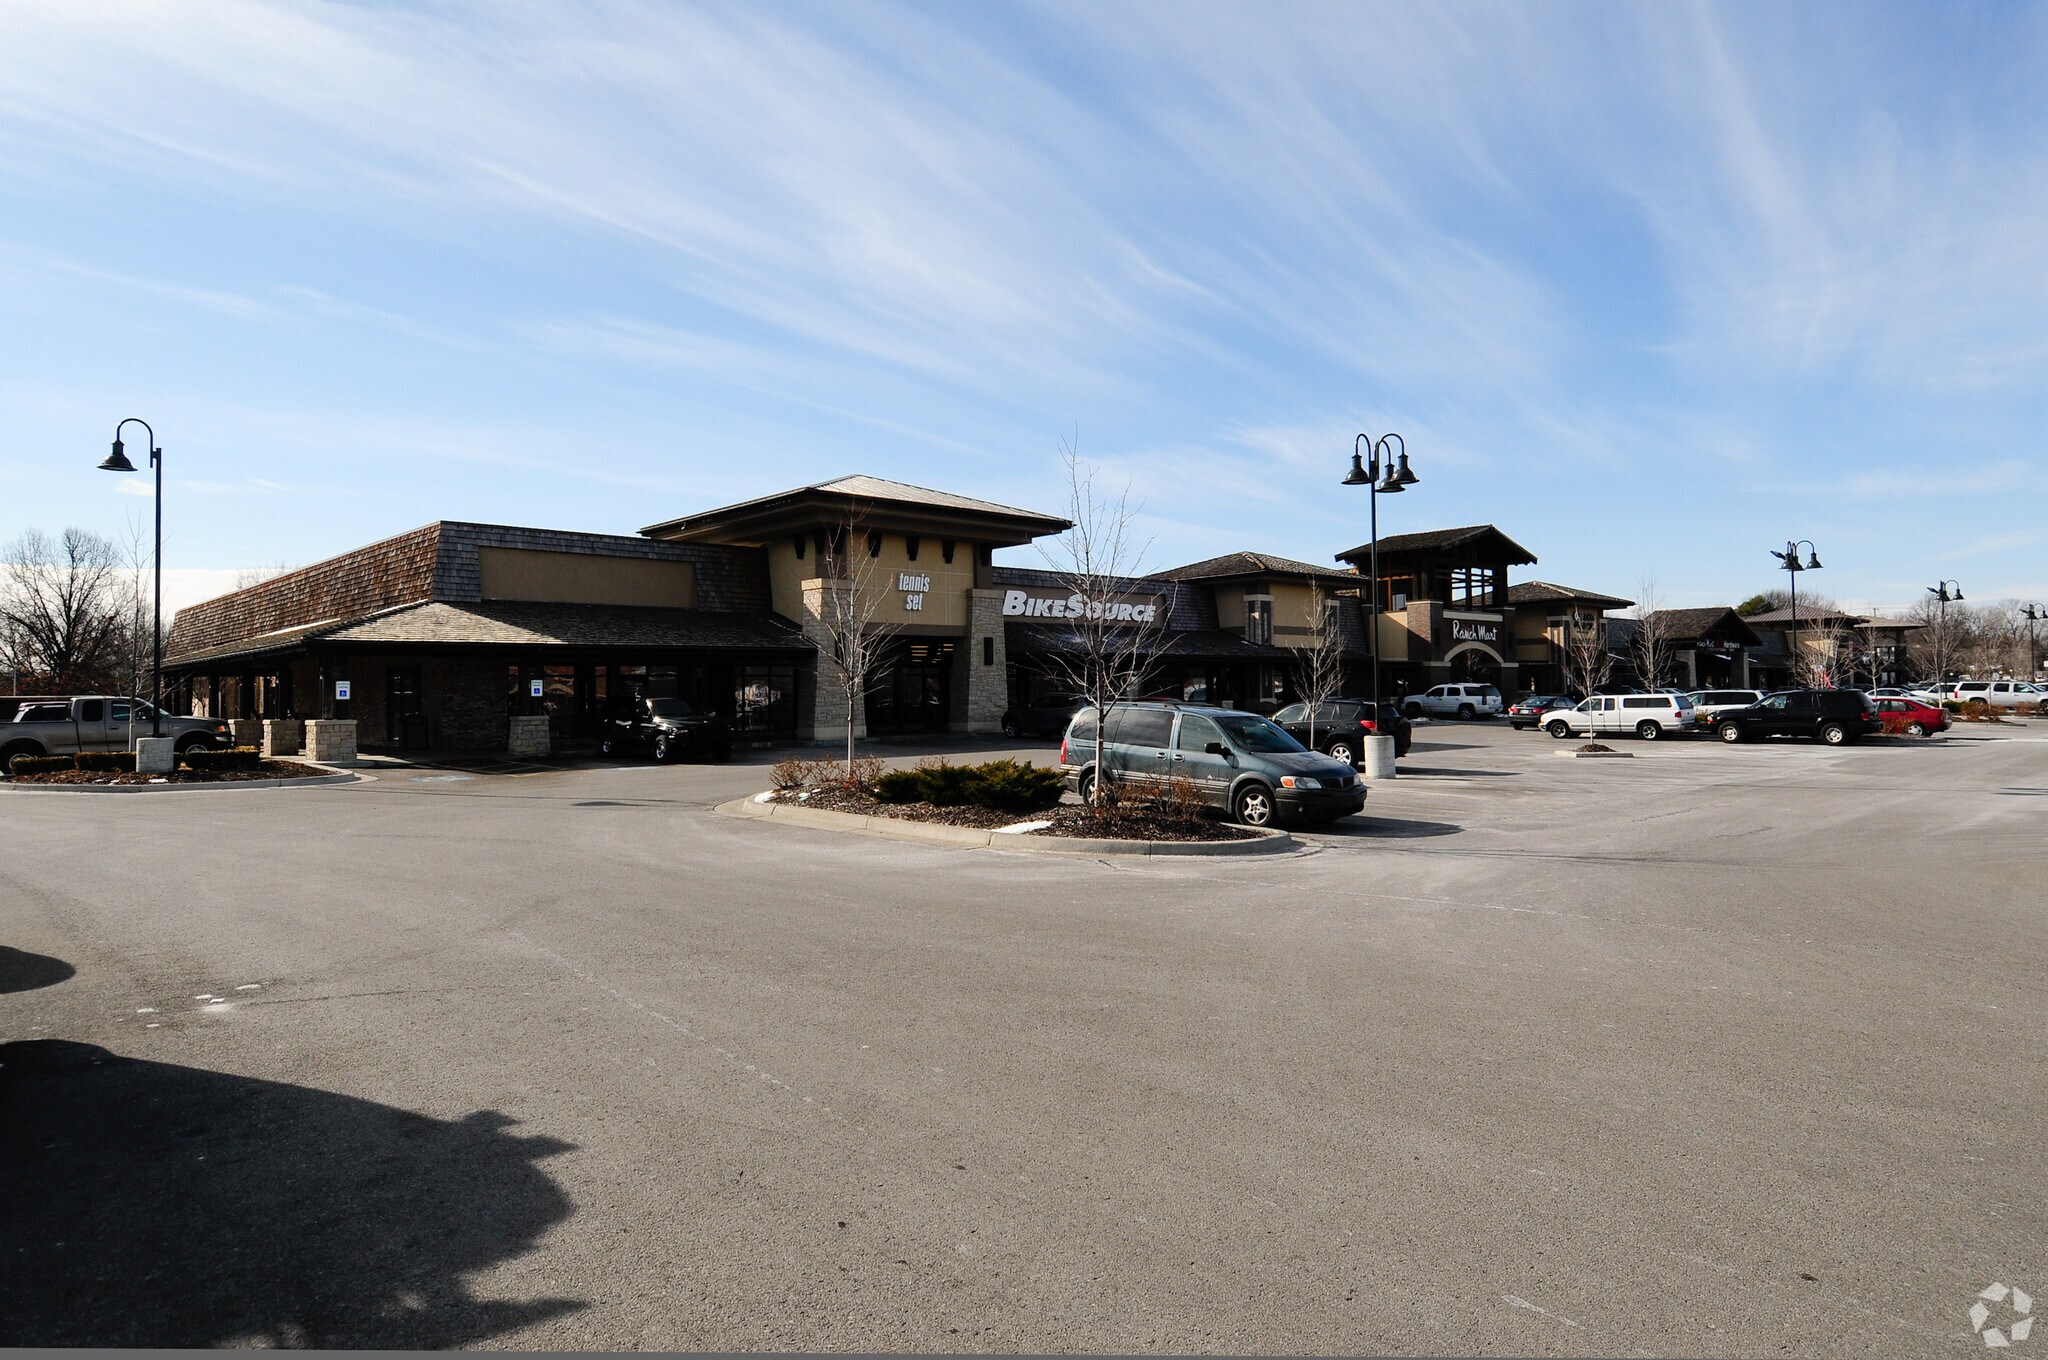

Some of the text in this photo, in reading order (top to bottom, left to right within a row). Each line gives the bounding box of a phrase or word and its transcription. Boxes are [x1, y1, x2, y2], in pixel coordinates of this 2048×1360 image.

[899, 572, 930, 592] tennis
[906, 593, 923, 611] set
[1452, 619, 1498, 641] Ranch Mart
